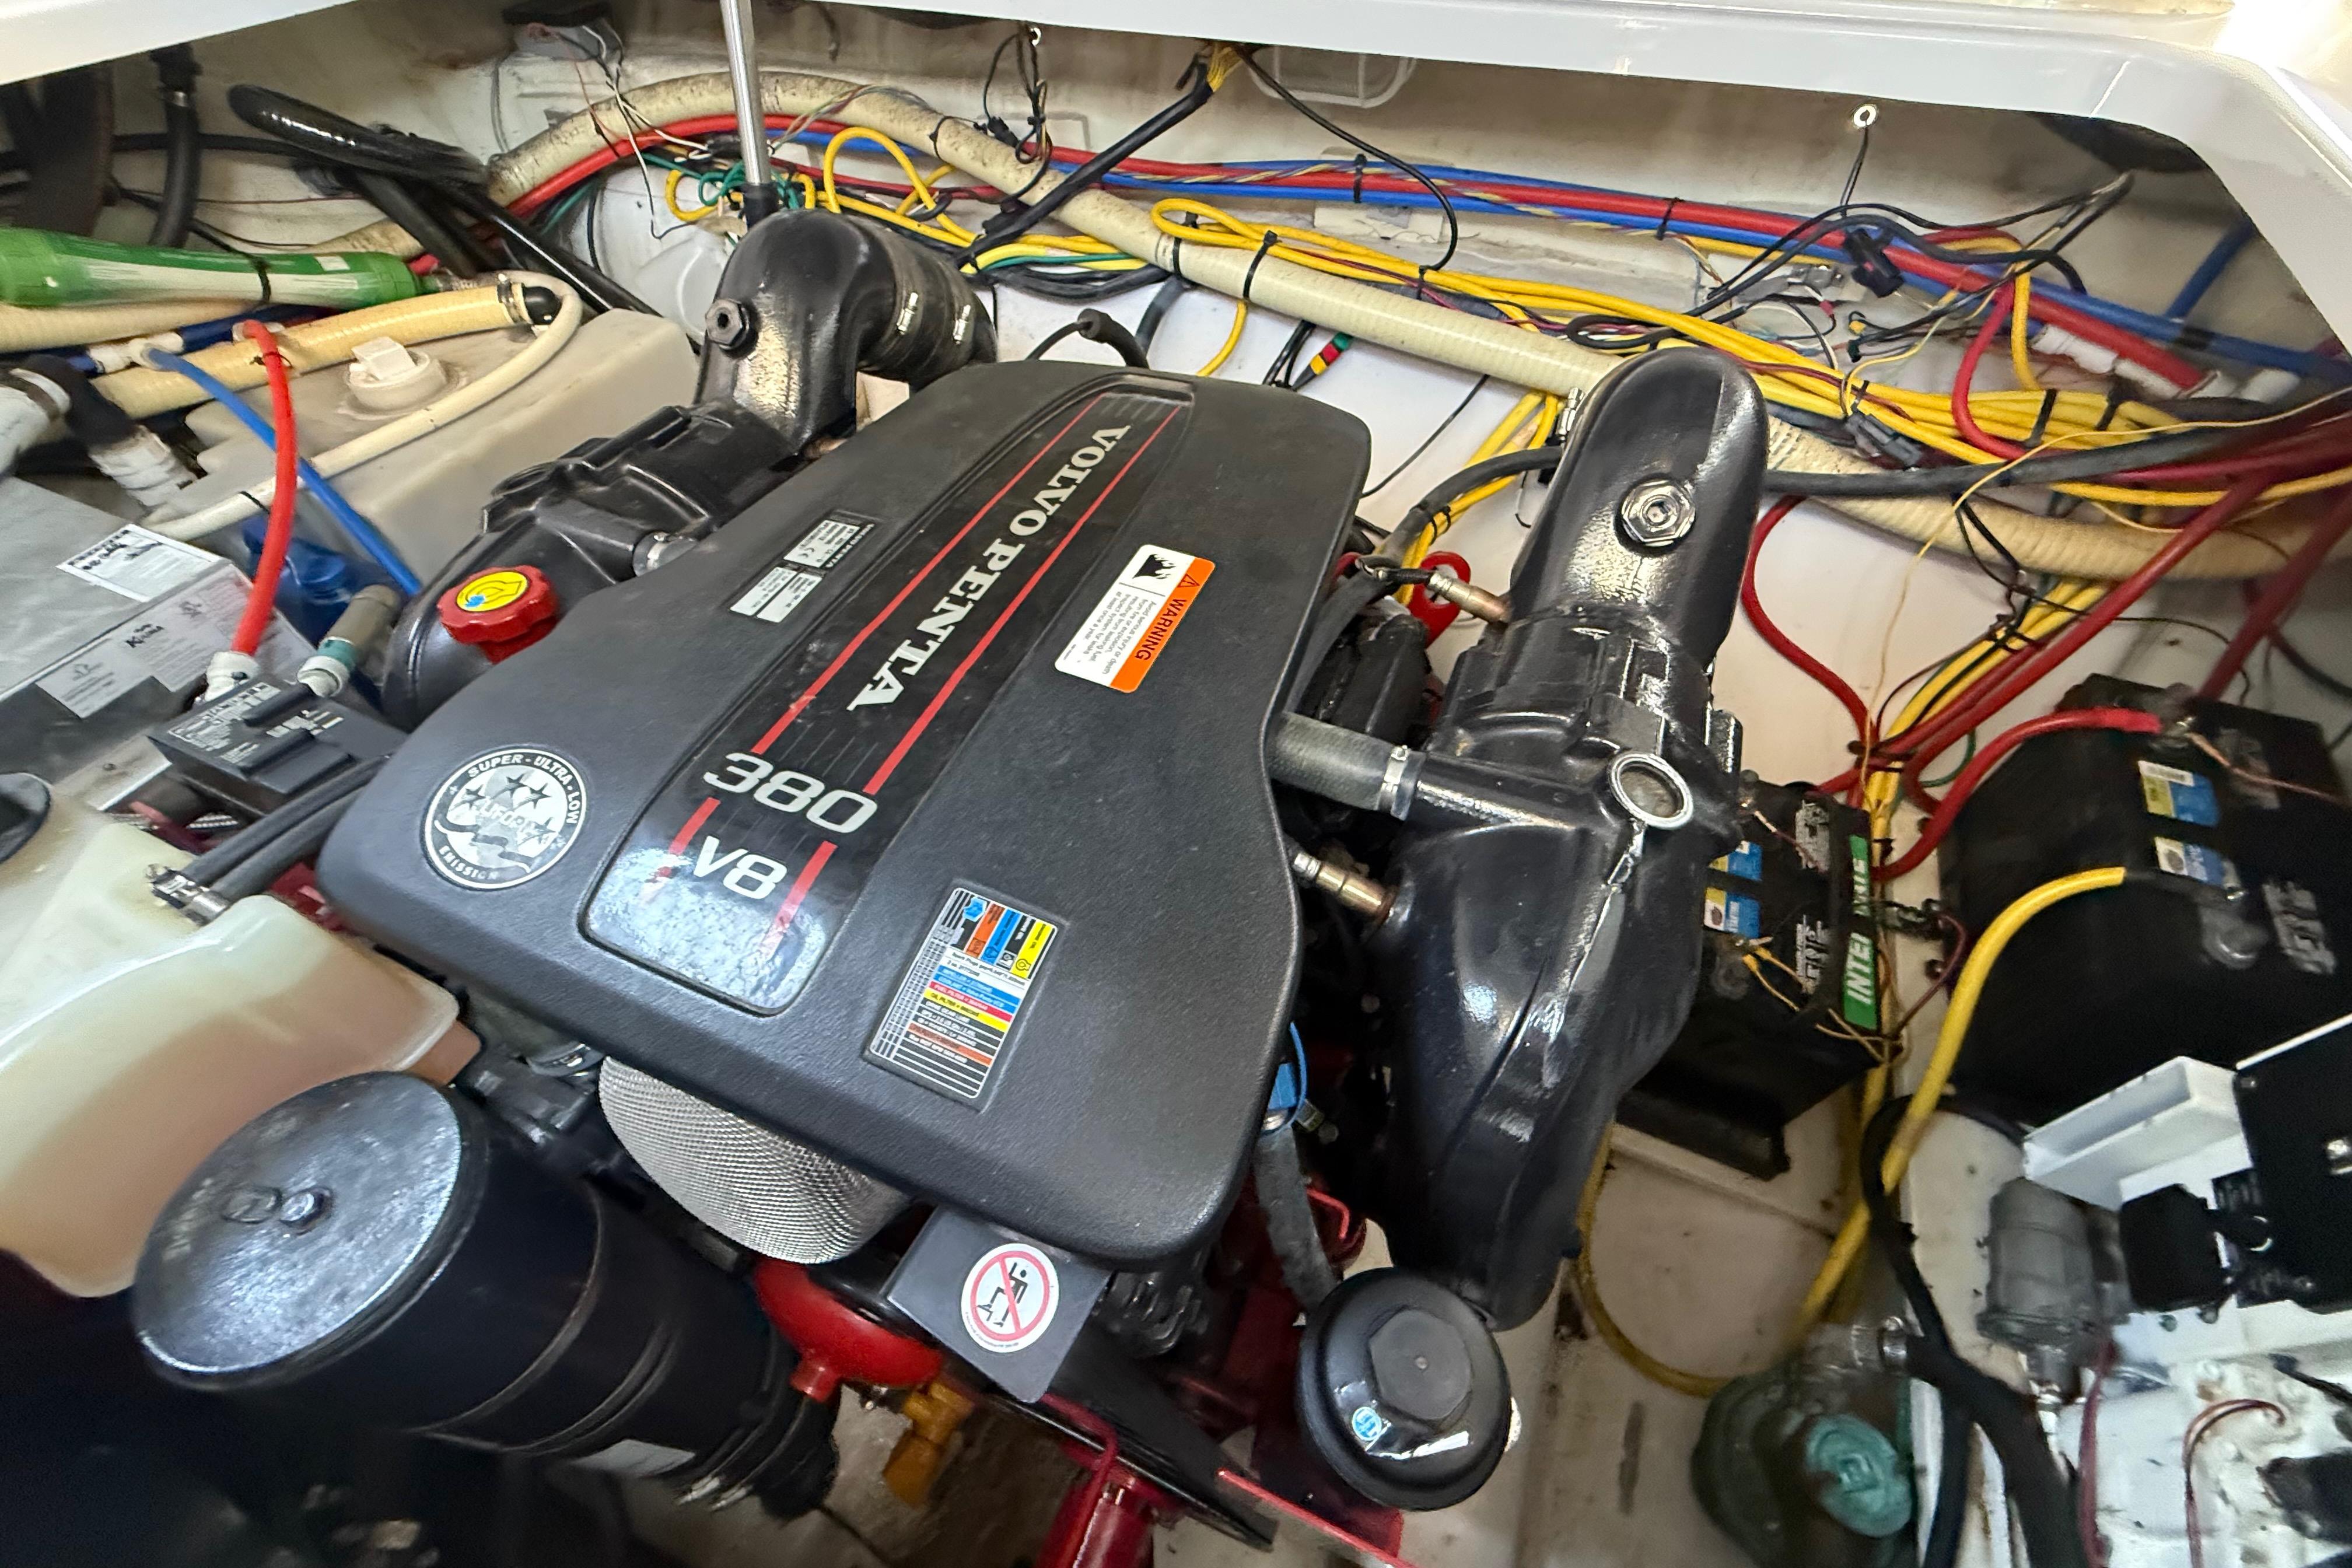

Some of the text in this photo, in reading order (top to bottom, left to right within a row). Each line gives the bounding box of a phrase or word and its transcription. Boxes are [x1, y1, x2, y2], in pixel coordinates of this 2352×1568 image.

[846, 425, 1131, 711] VOLVO PENTA
[1135, 598, 1186, 660] WARNING
[467, 754, 580, 824] SUPER ULTRA LOW
[703, 752, 878, 834] 380
[439, 845, 500, 880] EMISSION
[693, 836, 788, 900] V8
